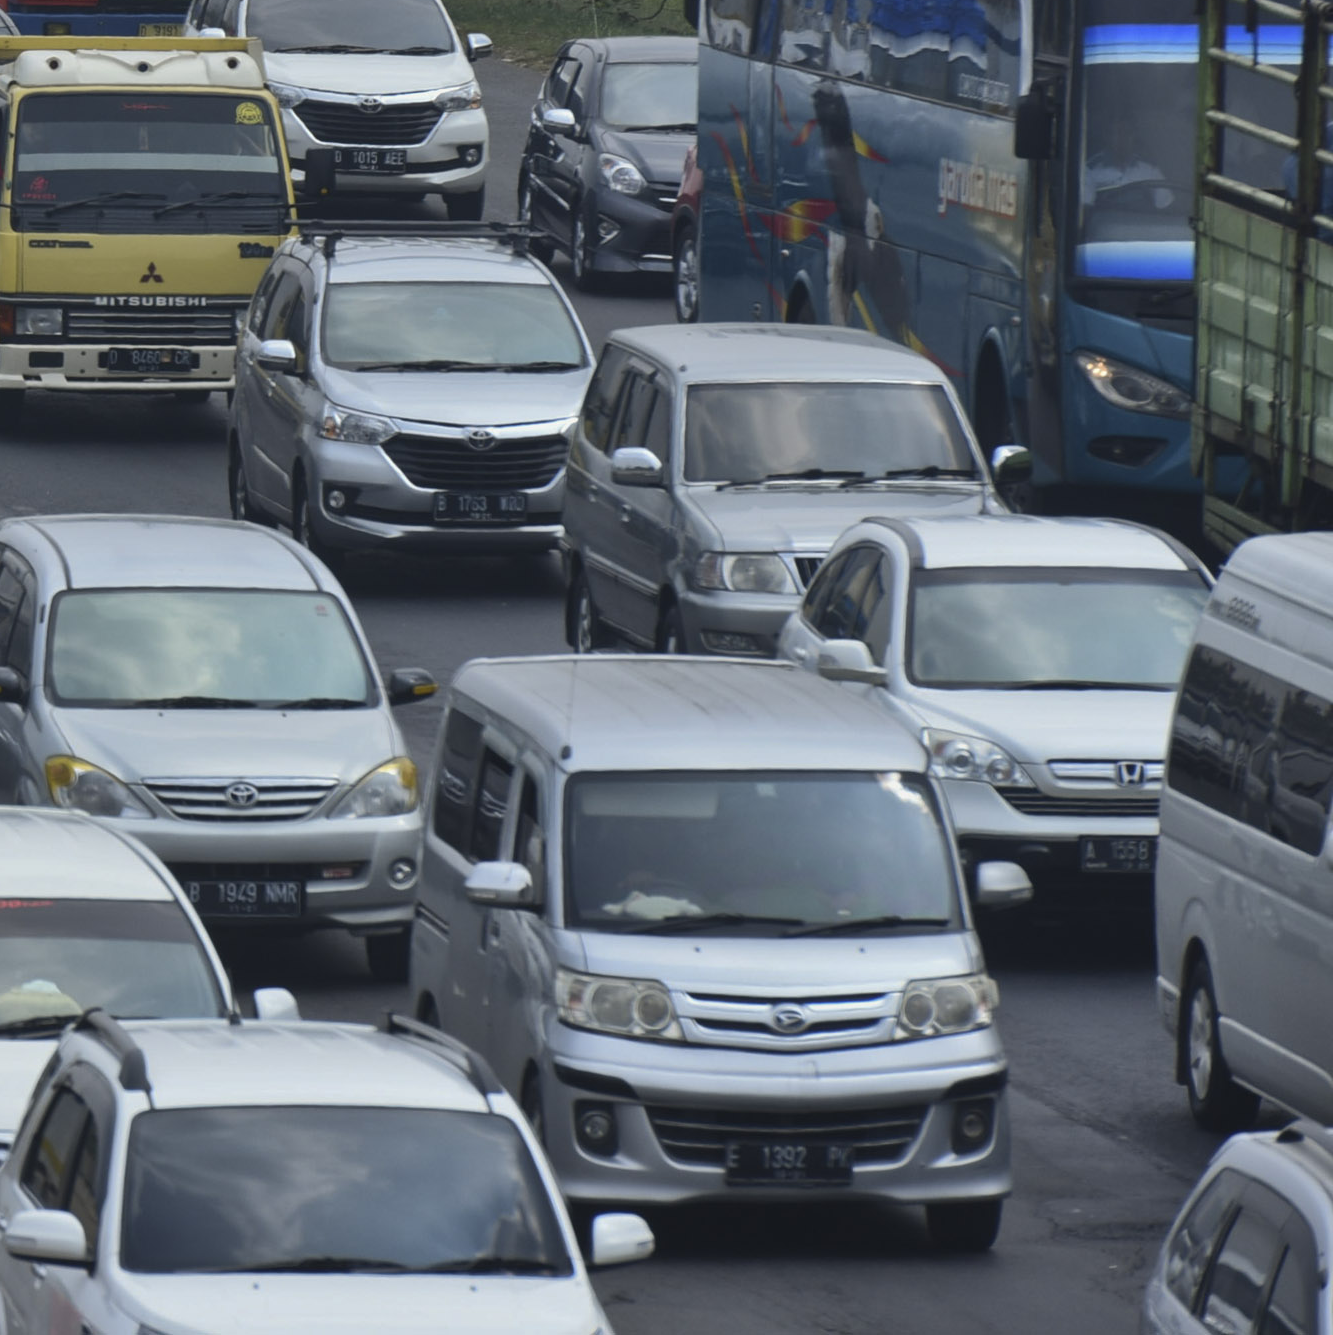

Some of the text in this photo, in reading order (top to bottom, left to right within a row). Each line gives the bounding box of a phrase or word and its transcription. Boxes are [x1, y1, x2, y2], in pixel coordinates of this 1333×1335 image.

[353, 151, 378, 164] 1015
[95, 296, 207, 307] MITSUBISHI
[1085, 840, 1150, 861] A 1558
[189, 882, 298, 904] B 1949 NMR
[763, 1145, 808, 1169] 1392
